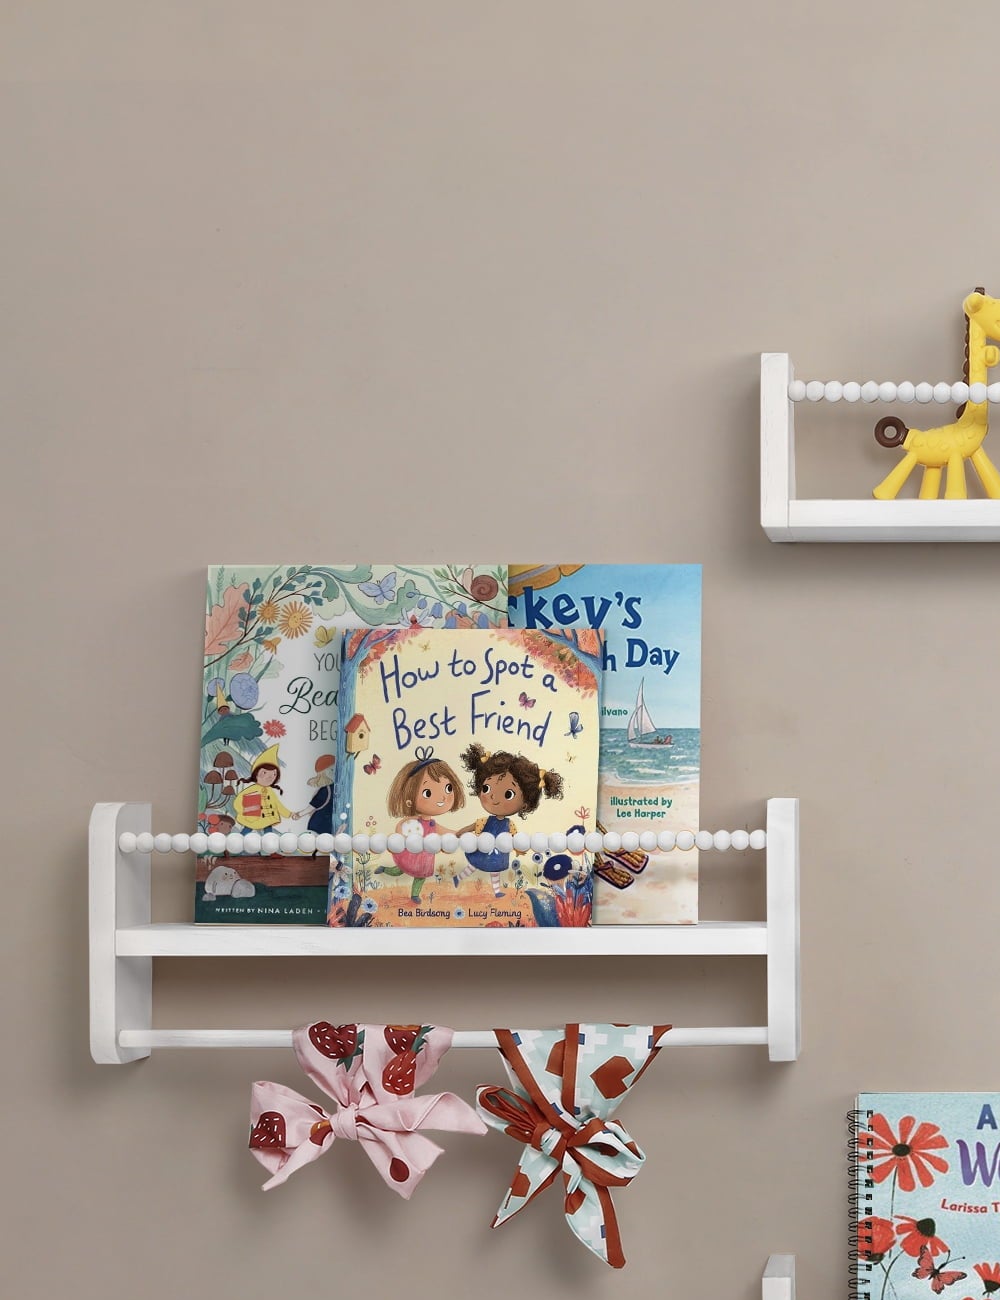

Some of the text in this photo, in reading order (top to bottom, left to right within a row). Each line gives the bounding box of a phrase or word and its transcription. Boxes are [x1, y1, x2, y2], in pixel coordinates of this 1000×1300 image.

[625, 638, 680, 675] Day
[380, 647, 557, 703] How to Spot a
[392, 689, 552, 750] Best Friend
[610, 796, 673, 808] illustrated by
[616, 809, 666, 820] Lee Harper
[398, 908, 451, 919] Bea Birdsong
[468, 908, 522, 919] Lucy Fleming
[976, 1103, 998, 1130] A
[940, 1198, 988, 1214] Larissa
